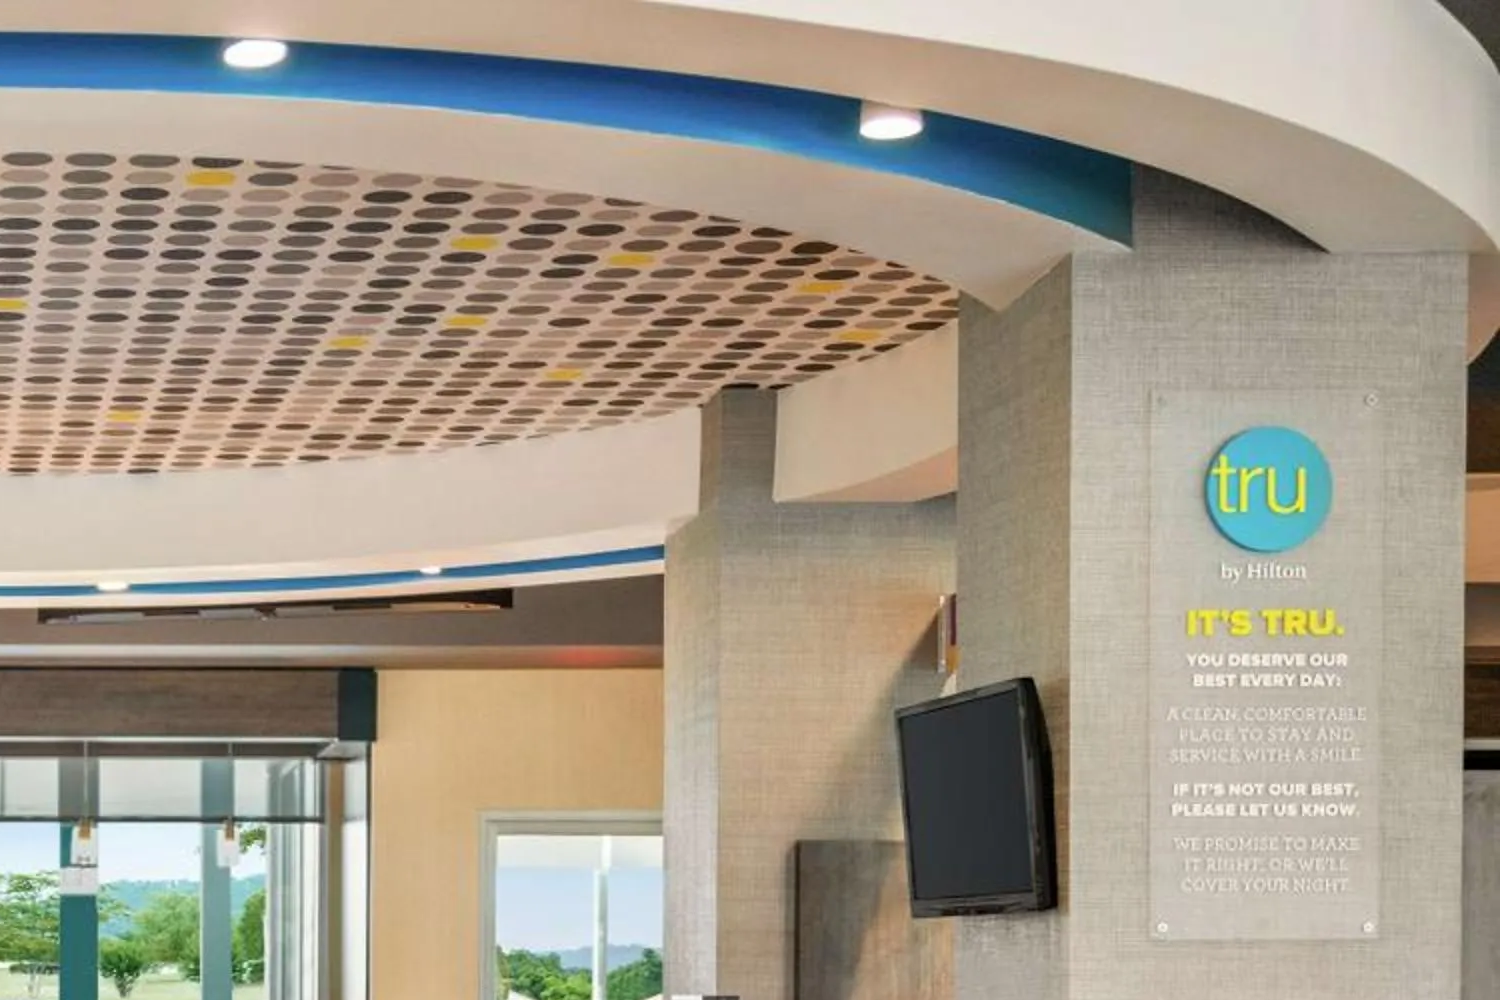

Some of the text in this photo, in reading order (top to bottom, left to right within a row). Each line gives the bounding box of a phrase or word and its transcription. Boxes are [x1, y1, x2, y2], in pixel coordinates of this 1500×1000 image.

[1211, 453, 1307, 513] tru
[1221, 562, 1307, 583] by Hilton
[1186, 608, 1345, 637] IT'S TRU.
[1186, 653, 1348, 667] YOU DESERVE OUR
[1193, 673, 1342, 687] BEST EVERY DAY:
[1166, 706, 1179, 720] A
[1243, 706, 1367, 721] COMFORTABLE
[1180, 727, 1355, 742] PLACE TO STAY AND
[1169, 747, 1241, 763] SERVICE
[1243, 747, 1291, 762] WITH
[1295, 747, 1306, 761] A
[1173, 783, 1189, 796] IF
[1193, 783, 1225, 796] IT'S
[1229, 783, 1265, 796] NOT
[1268, 783, 1306, 796] OUR
[1171, 803, 1237, 817] PLEASE
[1239, 803, 1269, 816] LET
[1273, 803, 1298, 817] US
[1173, 836, 1361, 851] WE PROMISE TO MAKE
[1184, 857, 1202, 872] IT
[1269, 857, 1296, 872] OR
[1181, 876, 1239, 893] COVER
[1241, 876, 1290, 894] YOUR
